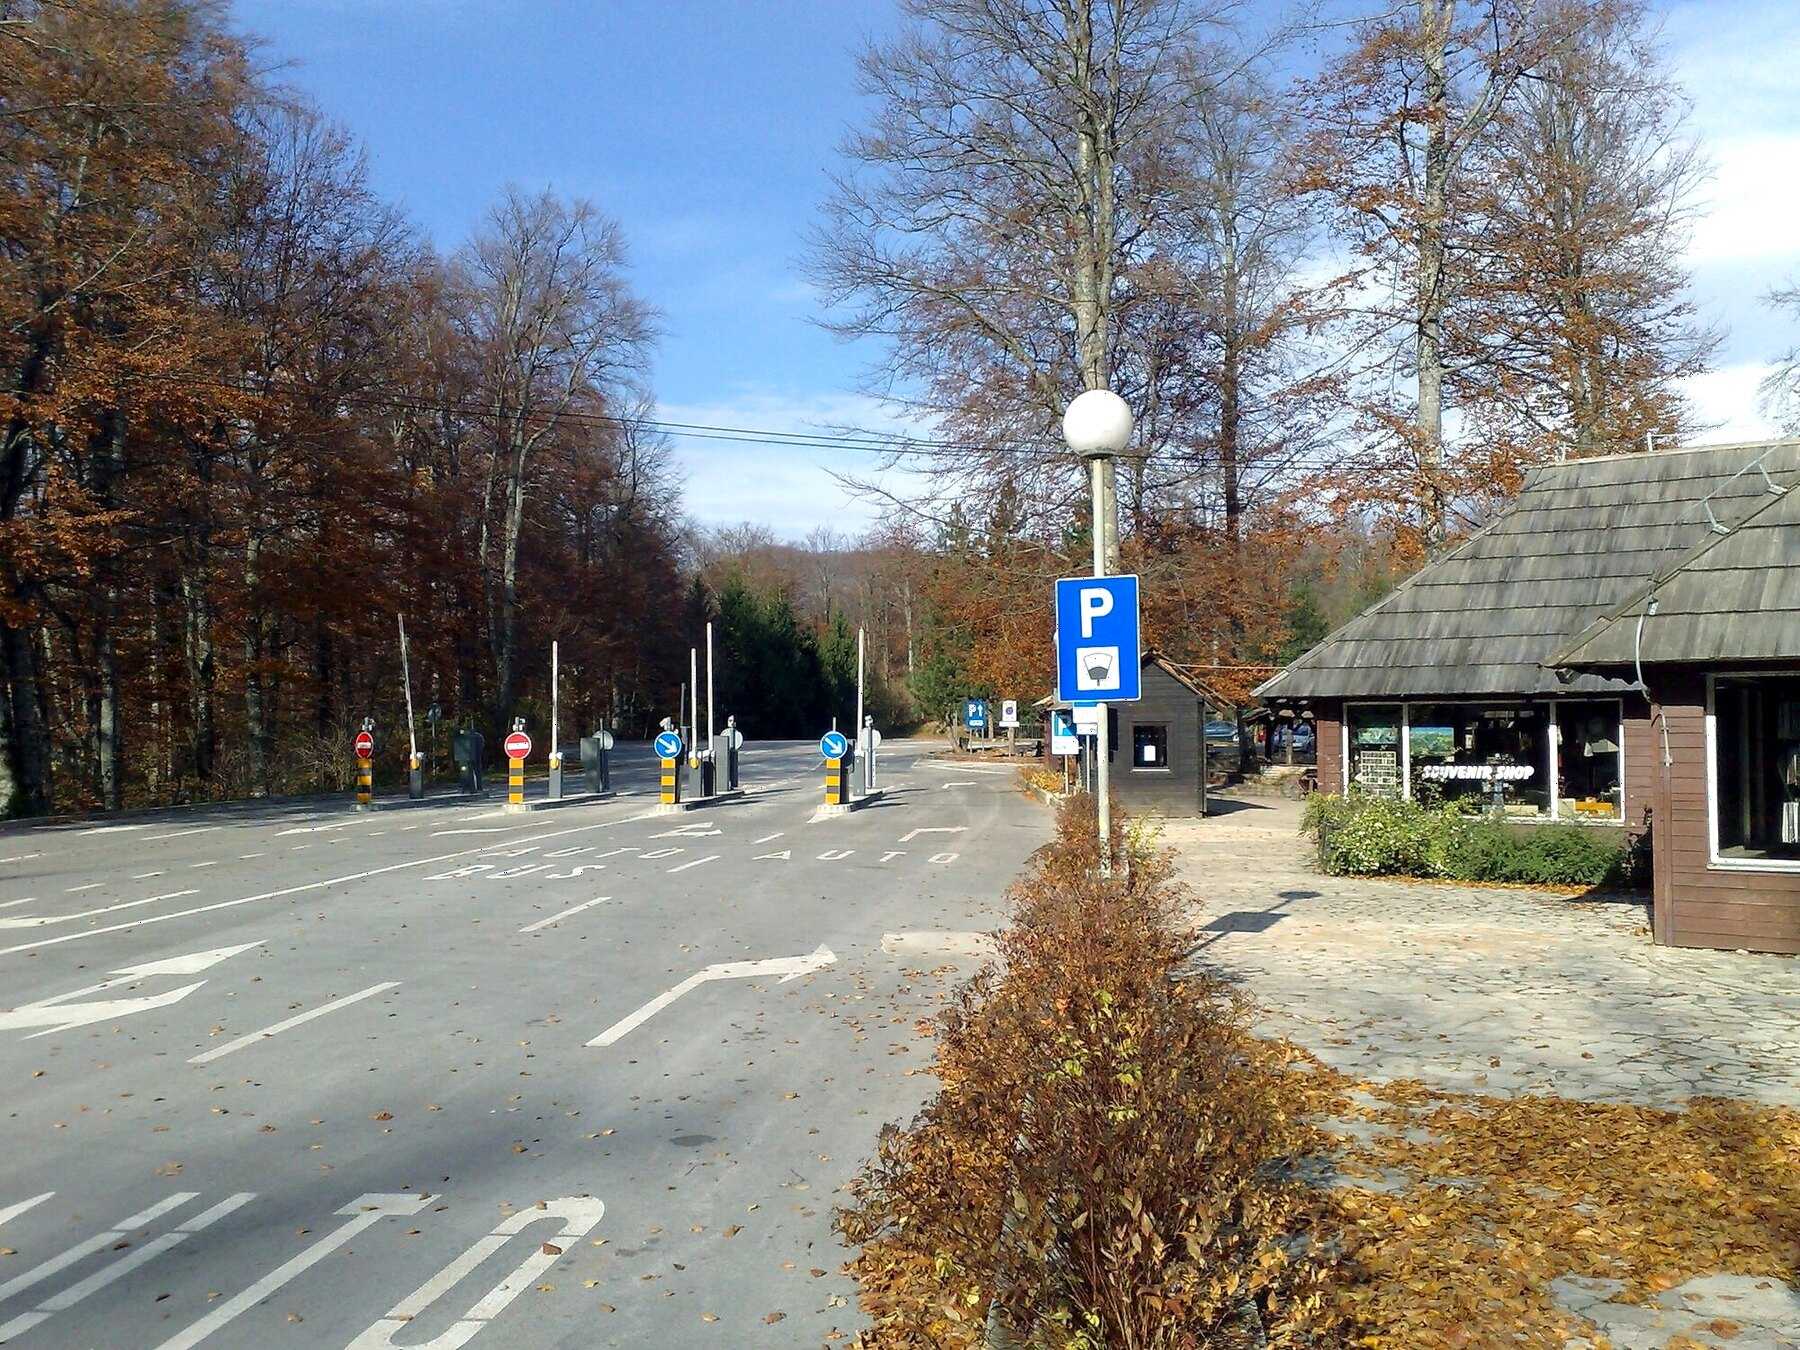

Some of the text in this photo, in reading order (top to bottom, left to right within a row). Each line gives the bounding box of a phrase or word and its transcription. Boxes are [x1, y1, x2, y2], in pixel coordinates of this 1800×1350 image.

[1080, 587, 1114, 638] P
[968, 703, 977, 718] P
[1422, 765, 1535, 780] SOUVENIR SHOP
[752, 849, 960, 864] AUTO
[422, 864, 606, 881] BUS
